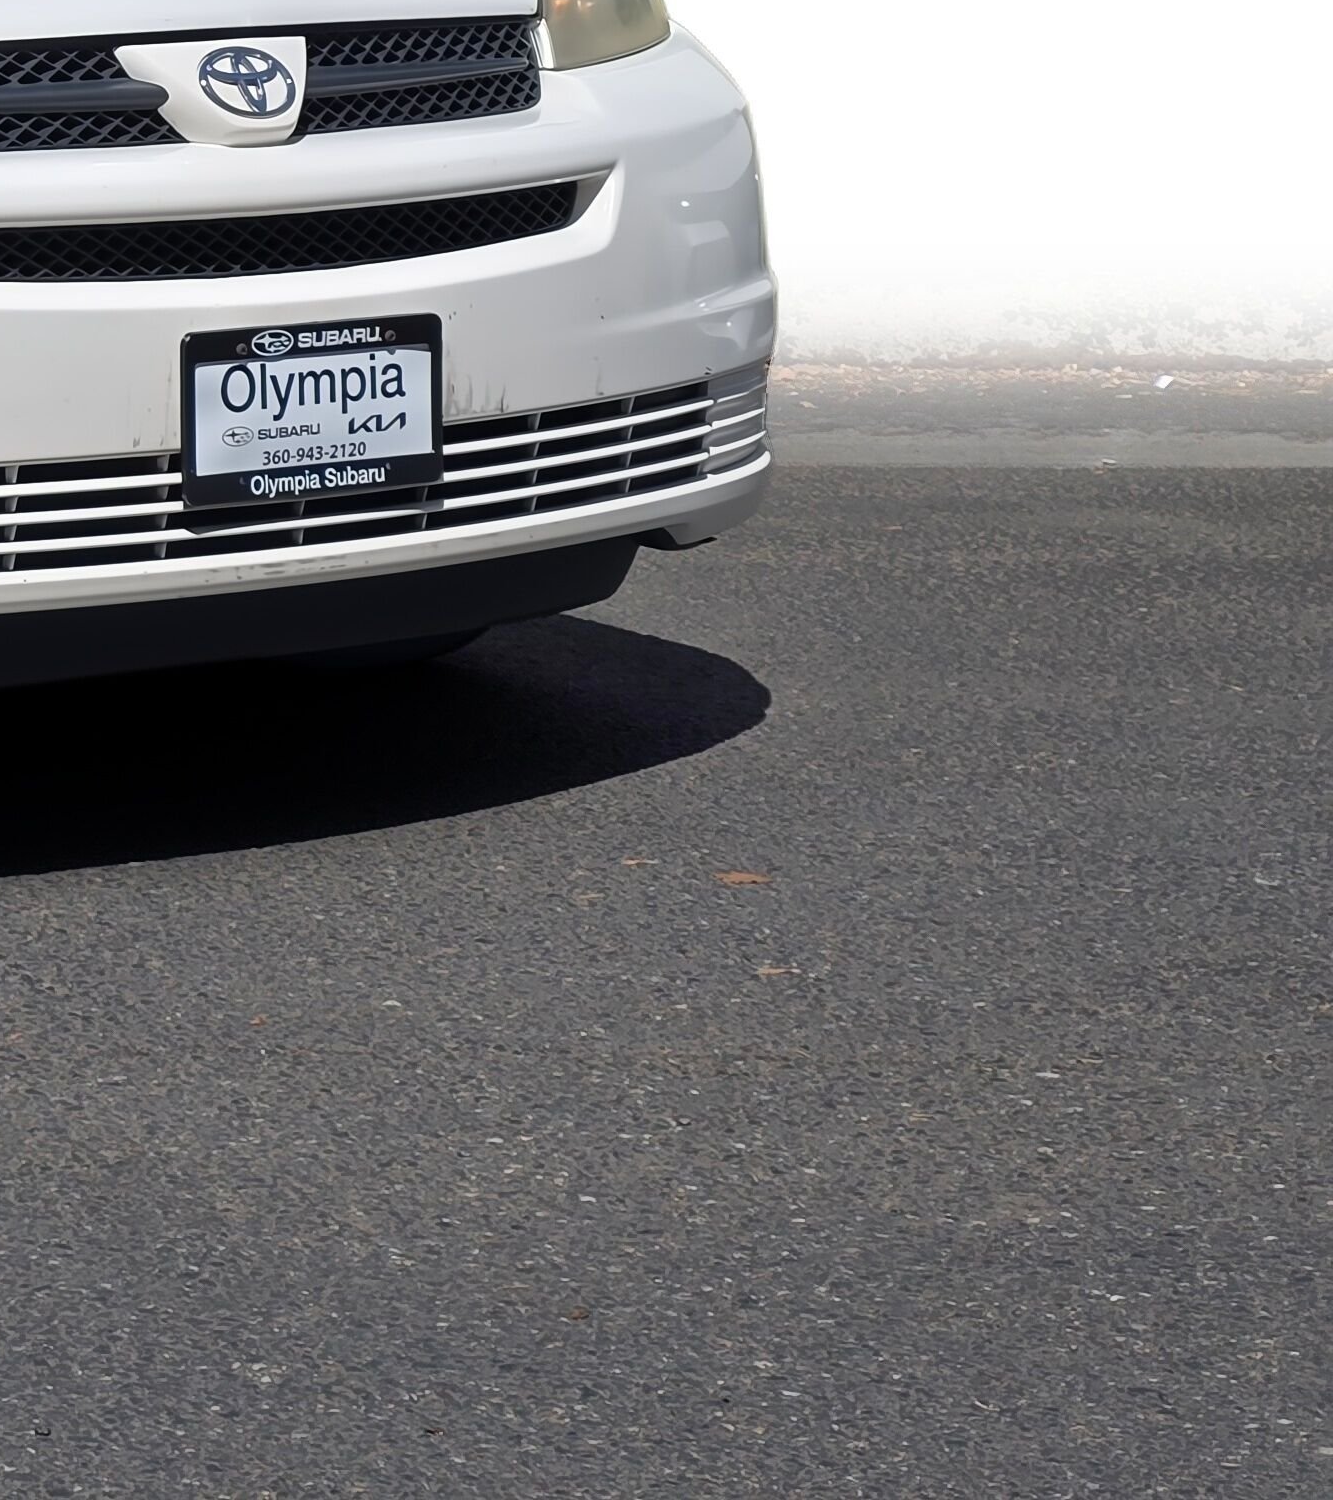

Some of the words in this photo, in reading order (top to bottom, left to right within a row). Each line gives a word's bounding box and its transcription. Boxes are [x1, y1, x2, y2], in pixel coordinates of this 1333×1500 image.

[220, 353, 407, 422] Olympia
[257, 422, 321, 440] SUBARU
[262, 441, 367, 466] 360-943-2120
[250, 469, 322, 498] Olympia
[324, 465, 386, 488] Subaru
